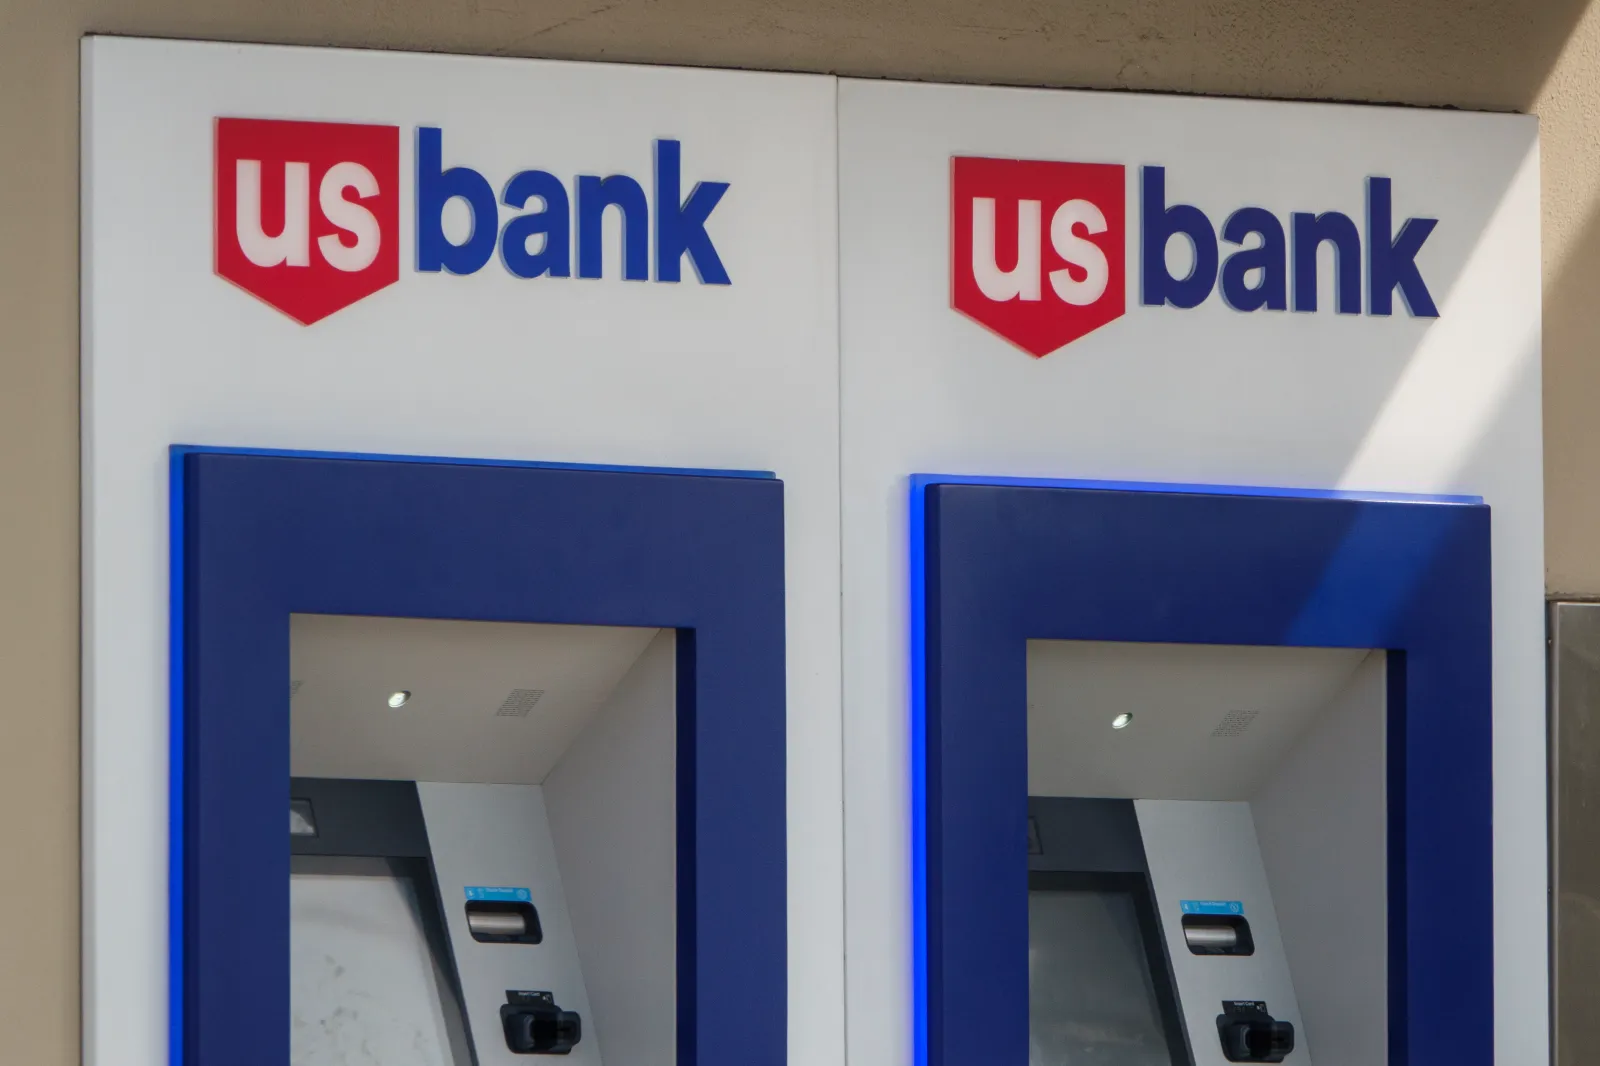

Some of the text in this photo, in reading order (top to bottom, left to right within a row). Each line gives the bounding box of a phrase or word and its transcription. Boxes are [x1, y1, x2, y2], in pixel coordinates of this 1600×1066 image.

[236, 126, 732, 285] us bank
[972, 165, 1440, 318] us bank
